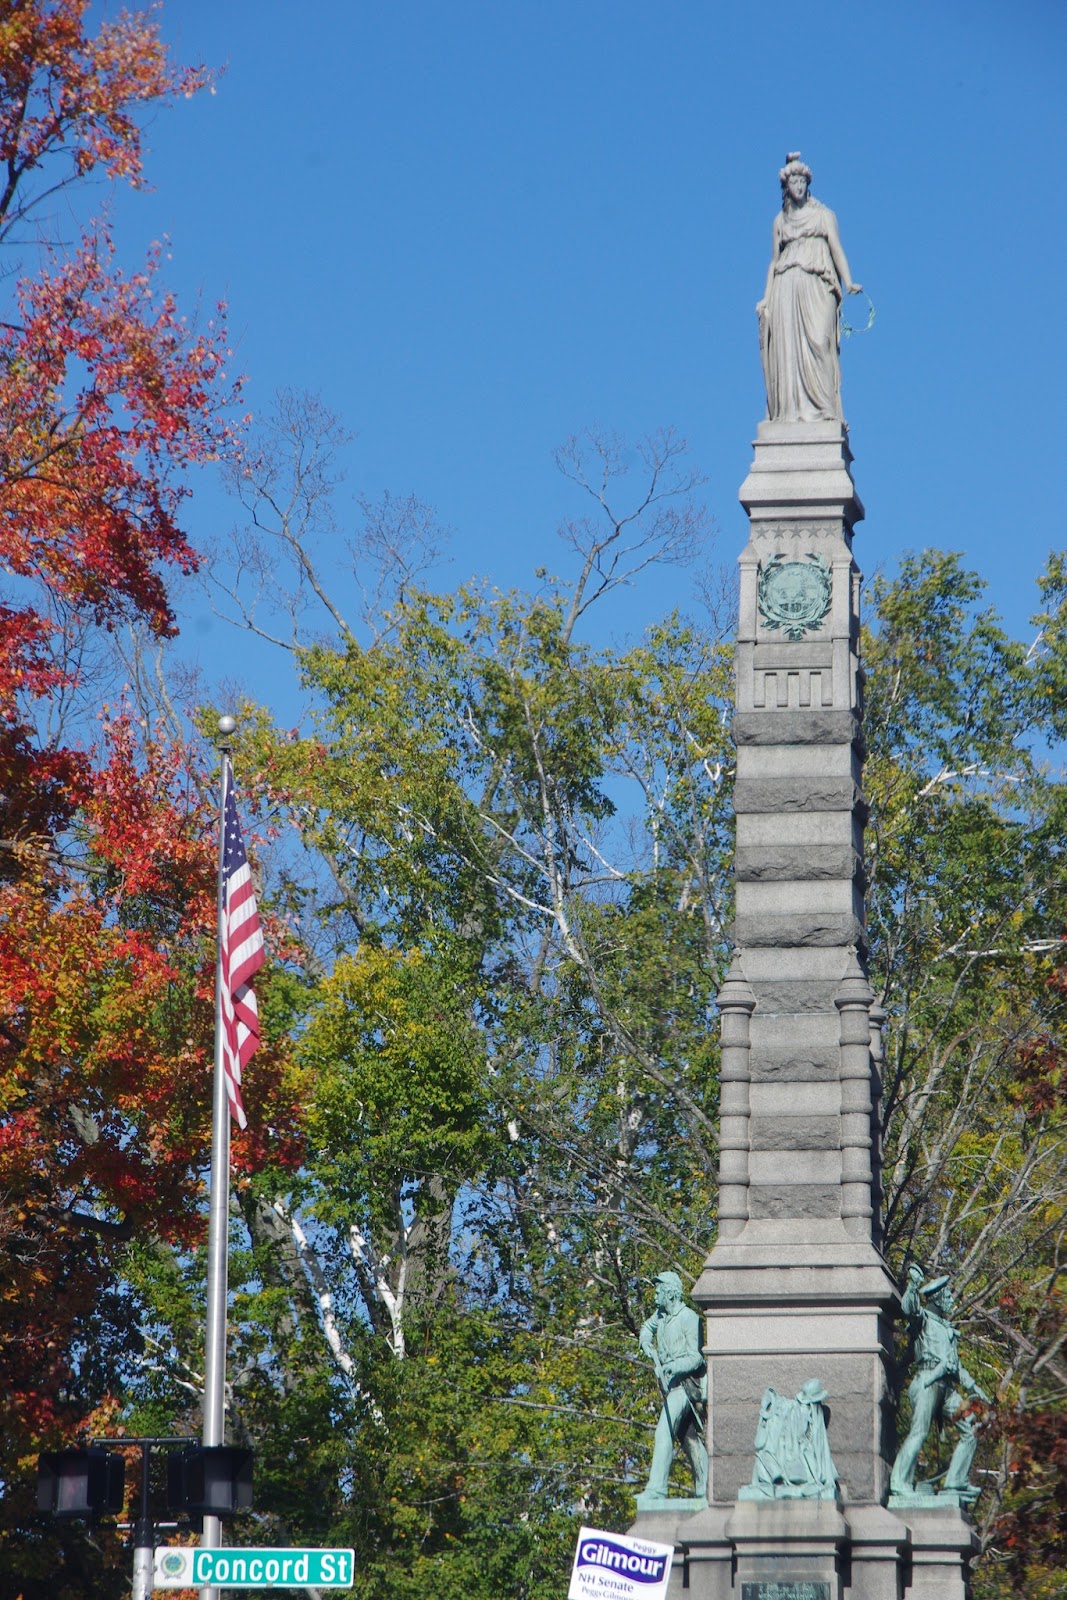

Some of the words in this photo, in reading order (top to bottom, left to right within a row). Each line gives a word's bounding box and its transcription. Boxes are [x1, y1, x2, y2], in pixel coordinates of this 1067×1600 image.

[581, 1543, 663, 1577] Gilmour
[633, 1541, 657, 1554] Peggy
[197, 1552, 309, 1582] Concord
[320, 1553, 348, 1582] St
[578, 1572, 596, 1584] NH
[598, 1576, 634, 1592] Senate
